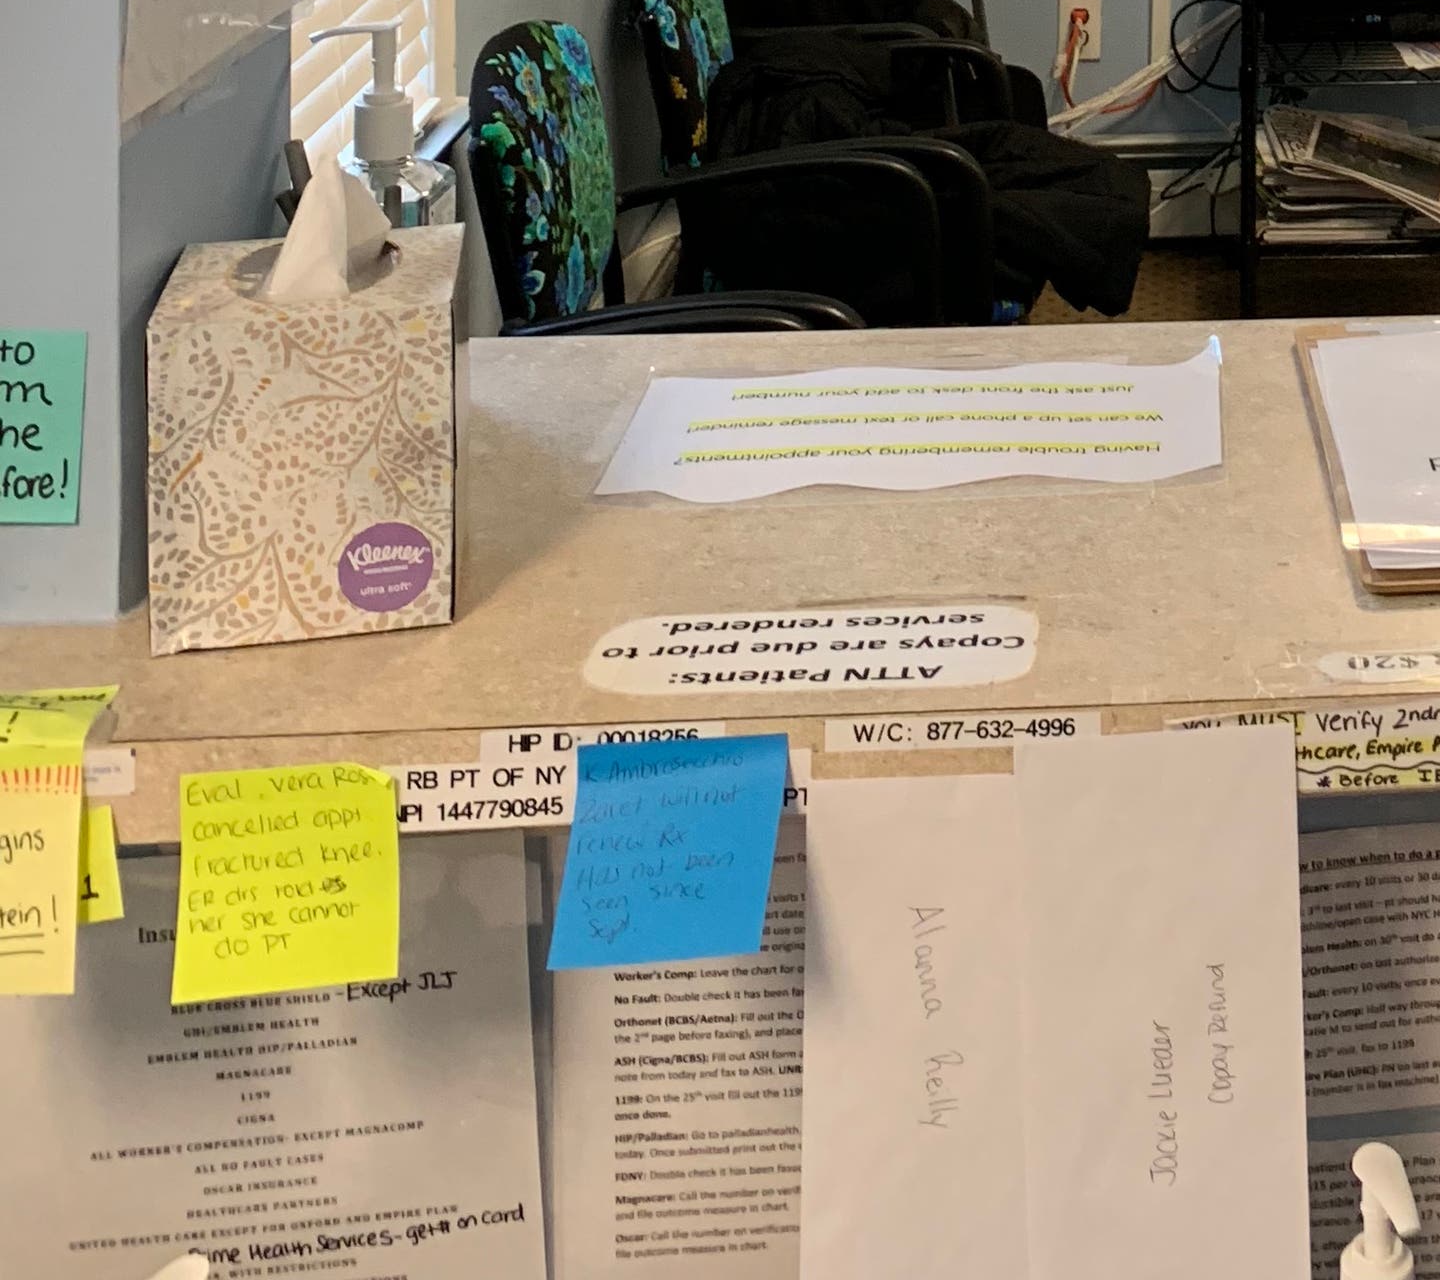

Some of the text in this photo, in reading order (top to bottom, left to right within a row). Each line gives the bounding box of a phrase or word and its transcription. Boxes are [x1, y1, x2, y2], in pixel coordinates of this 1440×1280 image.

[0, 340, 35, 366] to
[732, 384, 1135, 401] Just ask the front desk to add your number!
[686, 413, 1164, 434] We can set up a phone call or text message reminder!
[673, 443, 1161, 466] Having trouble remembering your appointments?
[0, 458, 69, 499] fore!
[346, 543, 426, 571] Kleenex
[360, 585, 385, 596] ultra
[661, 613, 986, 636] services rendered.
[602, 635, 1026, 659] Copays are due prior to
[668, 664, 943, 685] ATTN Patients:
[1348, 654, 1420, 670] $20
[853, 717, 1077, 743] W/C: 877-632-4996
[1315, 711, 1384, 737] Verify
[508, 734, 542, 754] HIP
[553, 732, 582, 751] ID:
[1365, 740, 1424, 760] Empire
[407, 765, 568, 790] RB PT OF NY
[1338, 769, 1400, 787] Before
[186, 779, 242, 807] Eval
[436, 795, 565, 821] 1447790845
[0, 828, 45, 864] gins
[194, 847, 305, 879] fractured
[81, 873, 99, 901] 1
[241, 910, 278, 931] she
[289, 902, 361, 925] cannot
[214, 932, 292, 960] do PT
[347, 977, 411, 1003] Except
[906, 905, 965, 1130] Alanna Reilly
[248, 1202, 526, 1263] Health on card
